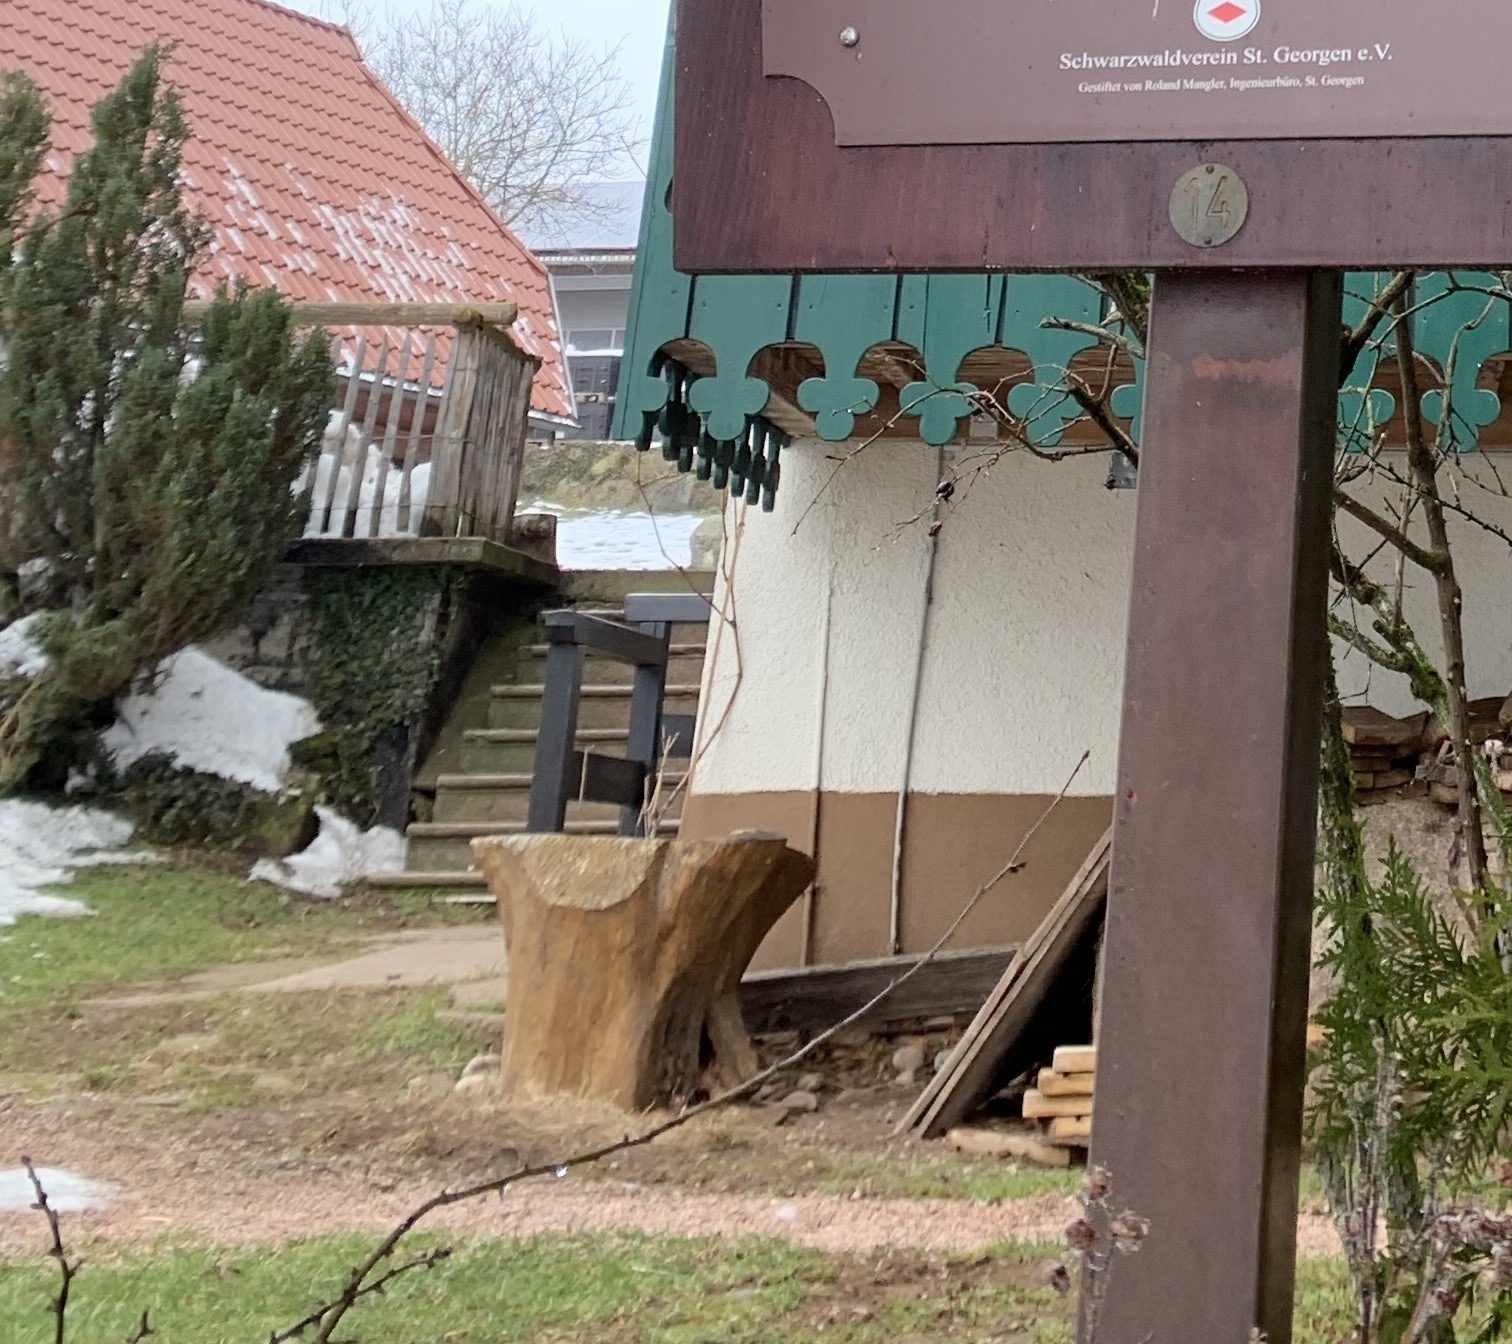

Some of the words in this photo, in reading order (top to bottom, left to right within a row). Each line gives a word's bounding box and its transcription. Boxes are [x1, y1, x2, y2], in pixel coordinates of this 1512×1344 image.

[1058, 47, 1238, 70] Schwarzwaldverein
[1242, 47, 1267, 64] St.
[1272, 46, 1352, 66] Georgen
[1356, 42, 1392, 61] e.V.
[1077, 80, 1121, 93] Gestiftet
[1122, 82, 1143, 91] von
[1143, 77, 1181, 91] Roland
[1320, 74, 1365, 88] Georgen
[1184, 176, 1230, 229] 14
